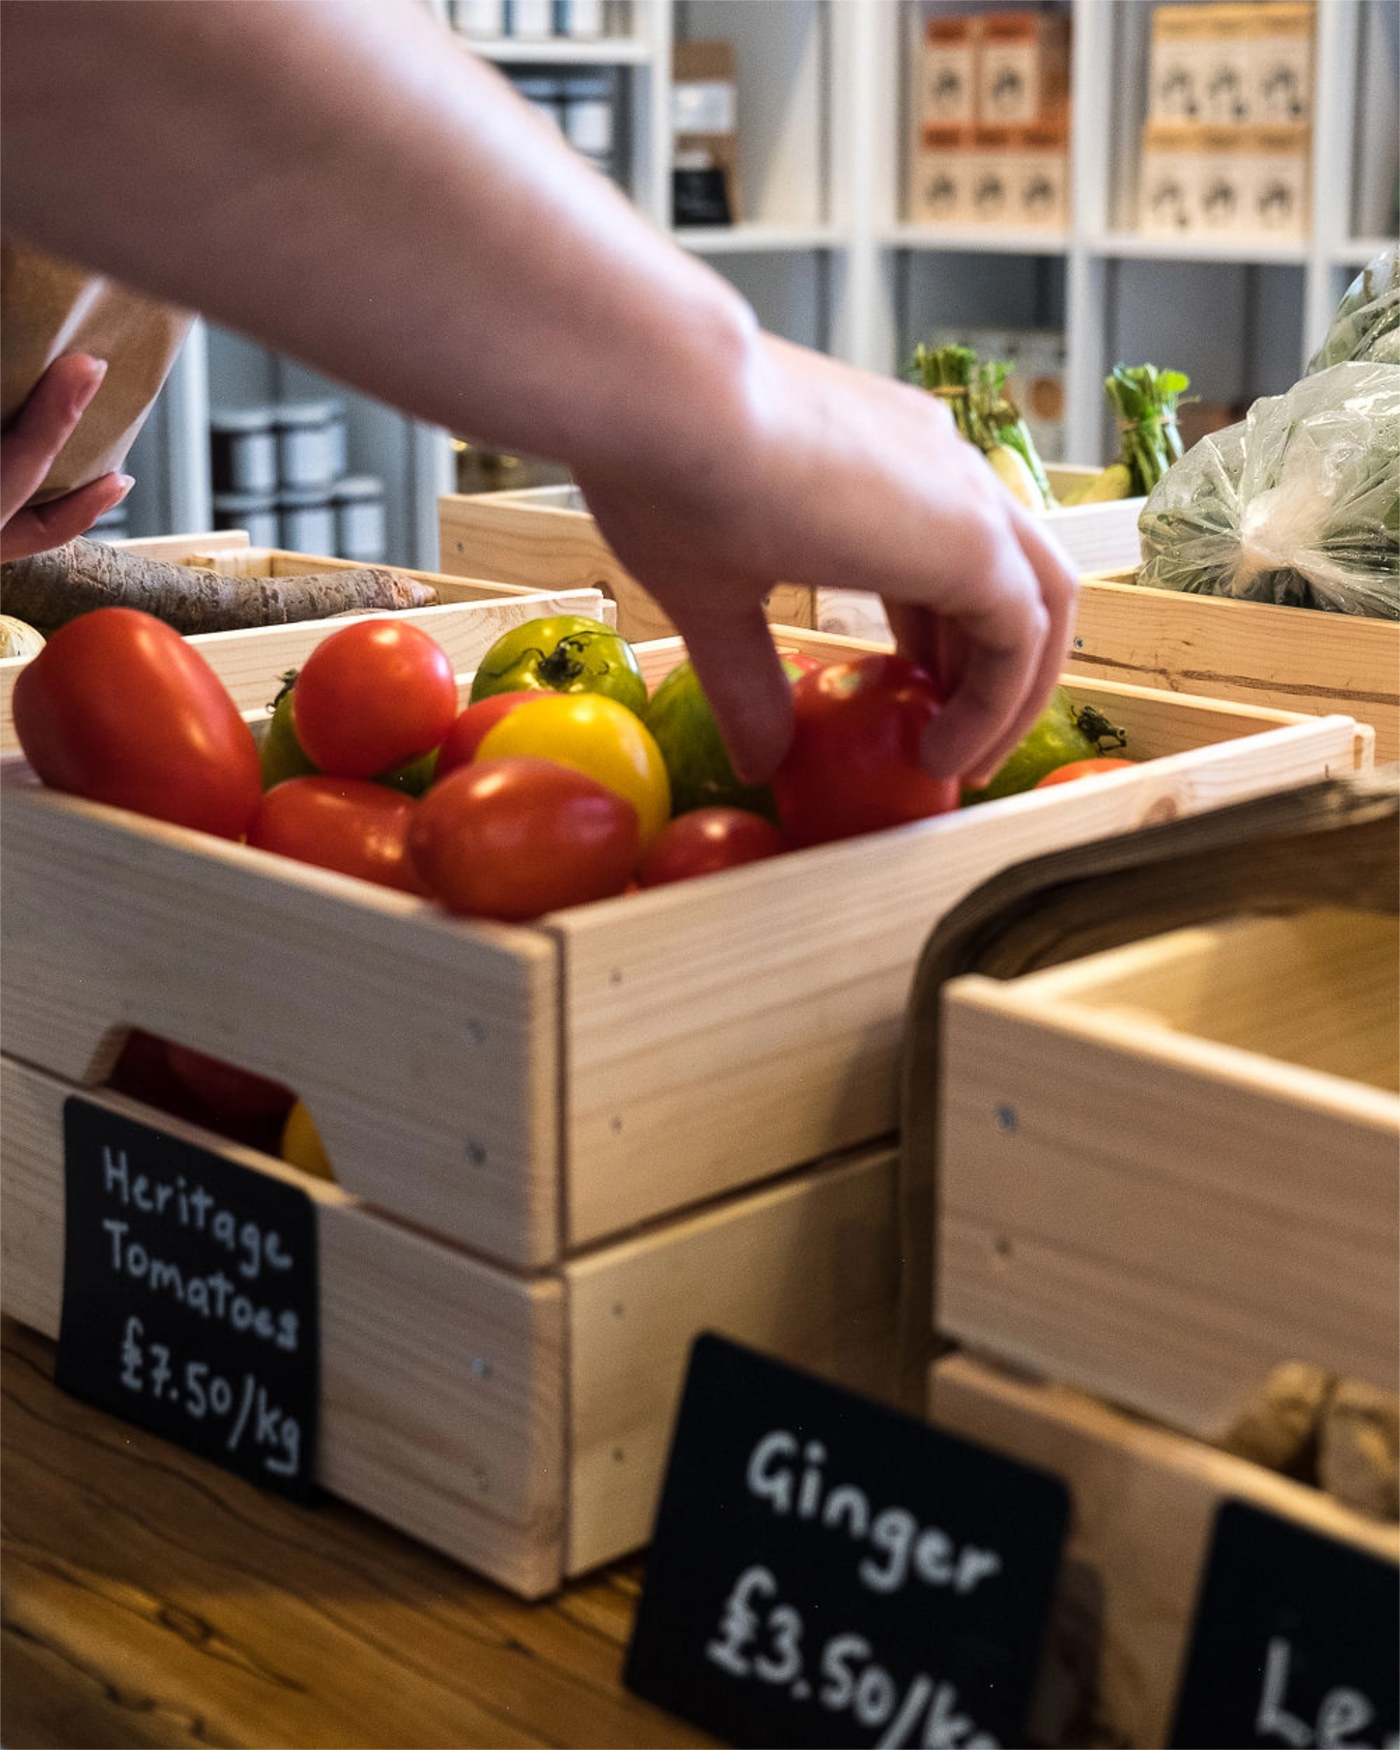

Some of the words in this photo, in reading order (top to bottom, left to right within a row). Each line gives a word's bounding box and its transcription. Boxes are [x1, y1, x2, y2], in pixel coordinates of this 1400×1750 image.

[103, 1145, 293, 1279] Heritage
[104, 1218, 299, 1352] Tomatoes
[120, 1315, 299, 1475] £7.50/kg
[747, 1430, 999, 1591] Ginger
[706, 1565, 1001, 1750] £3.50/k
[1256, 1636, 1400, 1750] Le
